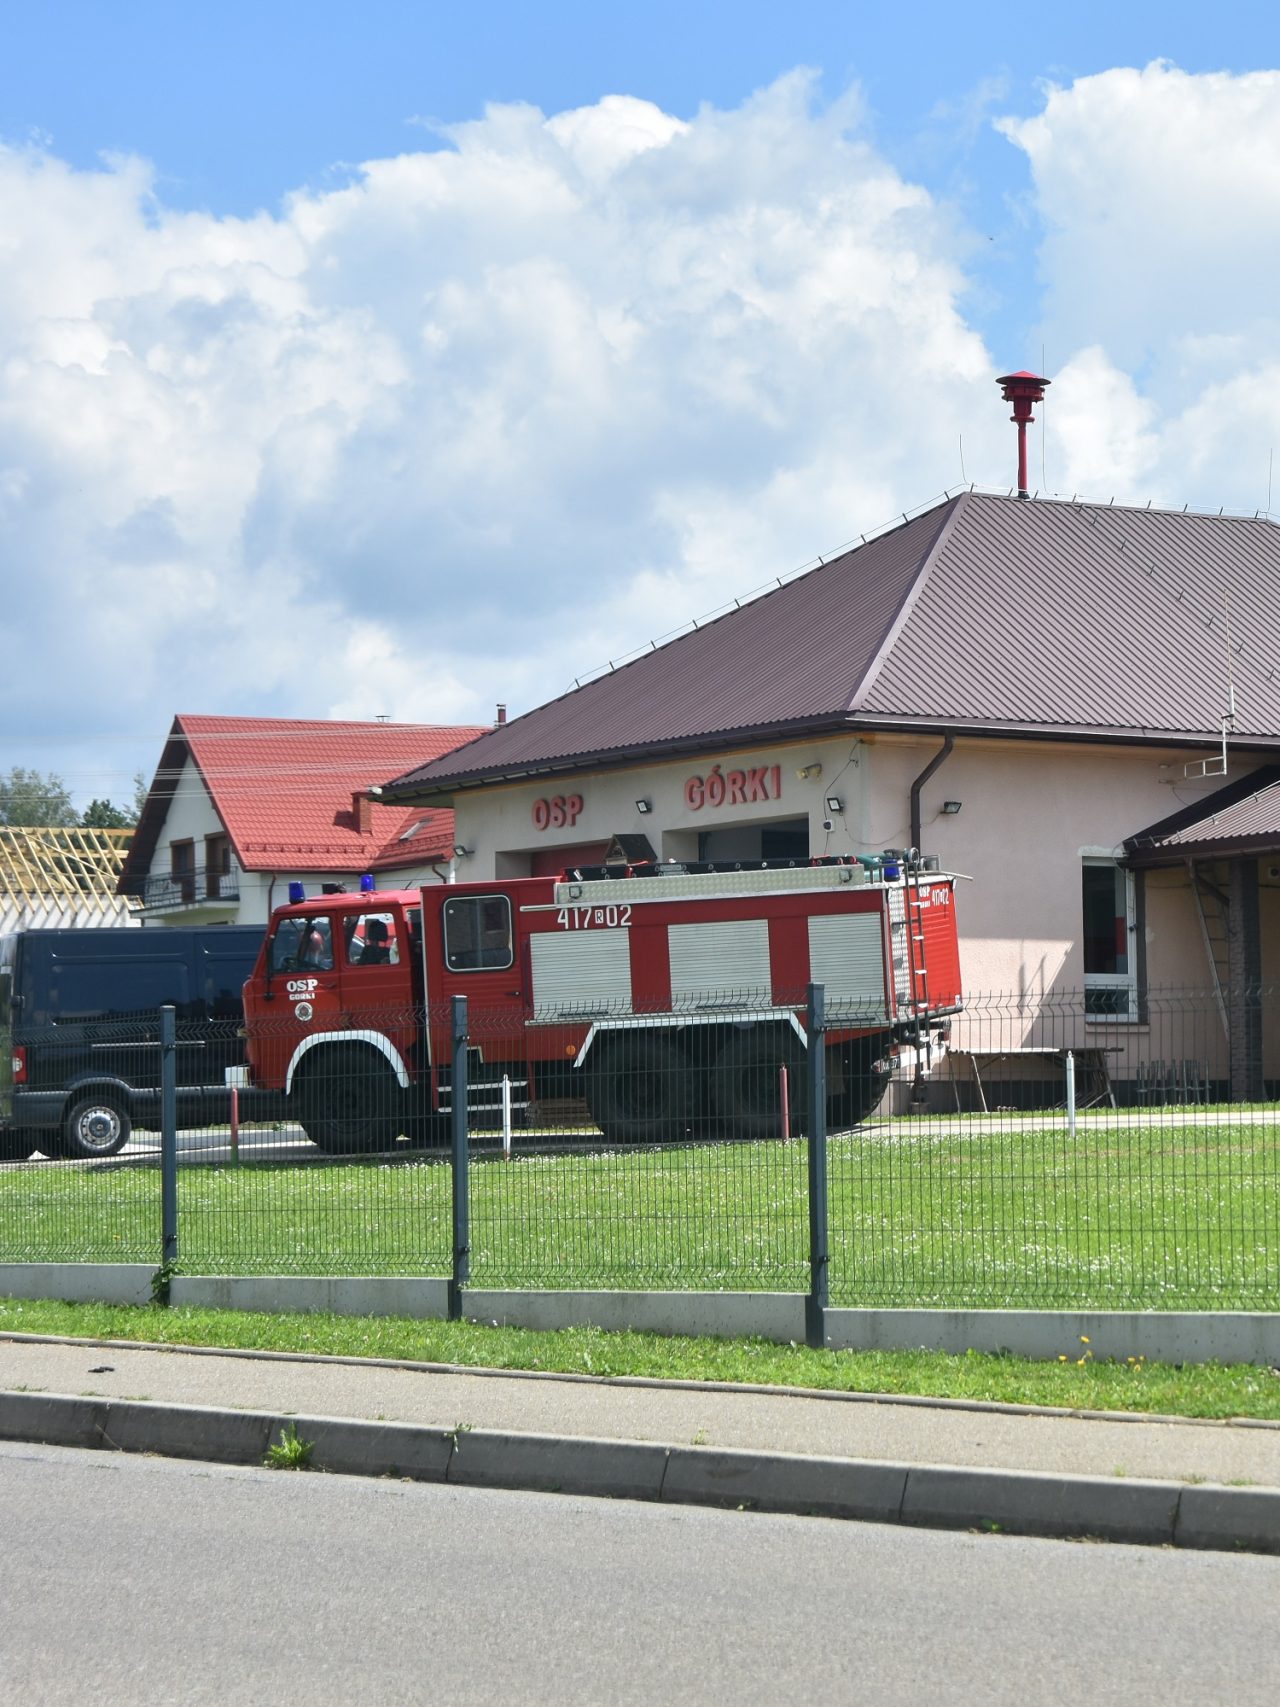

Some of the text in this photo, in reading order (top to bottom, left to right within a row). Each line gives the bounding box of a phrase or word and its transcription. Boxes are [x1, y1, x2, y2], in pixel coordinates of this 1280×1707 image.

[532, 764, 781, 831] OSP GÓRKI
[286, 979, 318, 992] OSP
